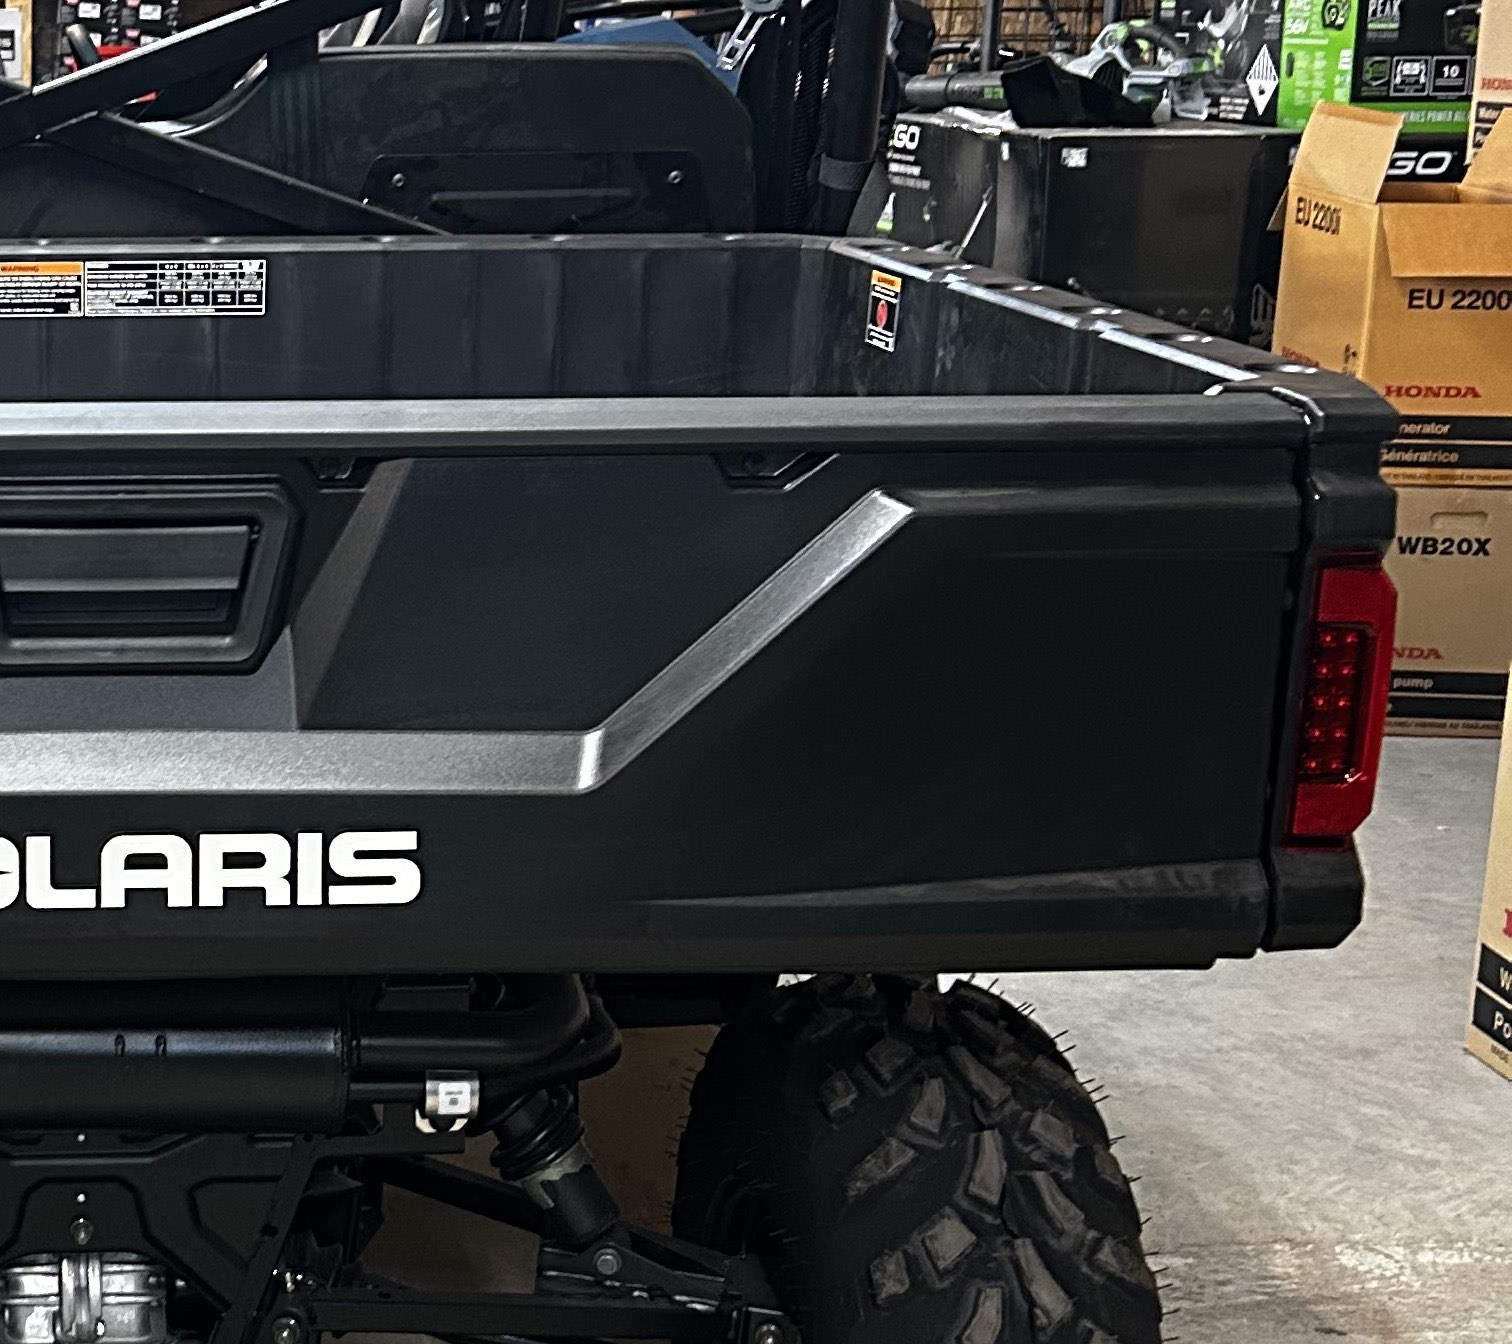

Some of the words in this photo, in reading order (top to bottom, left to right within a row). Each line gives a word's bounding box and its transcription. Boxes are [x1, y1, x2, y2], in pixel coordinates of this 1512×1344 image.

[1442, 64, 1461, 78] 10
[1388, 151, 1453, 175] GO
[1295, 196, 1312, 227] EU
[1312, 202, 1342, 236] 2200i
[1407, 288, 1445, 310] EU
[1384, 385, 1482, 399] HONDA
[1399, 423, 1452, 435] nerator
[1397, 536, 1492, 557] WB20X
[1392, 647, 1444, 660] NDA
[1393, 676, 1434, 690] pump
